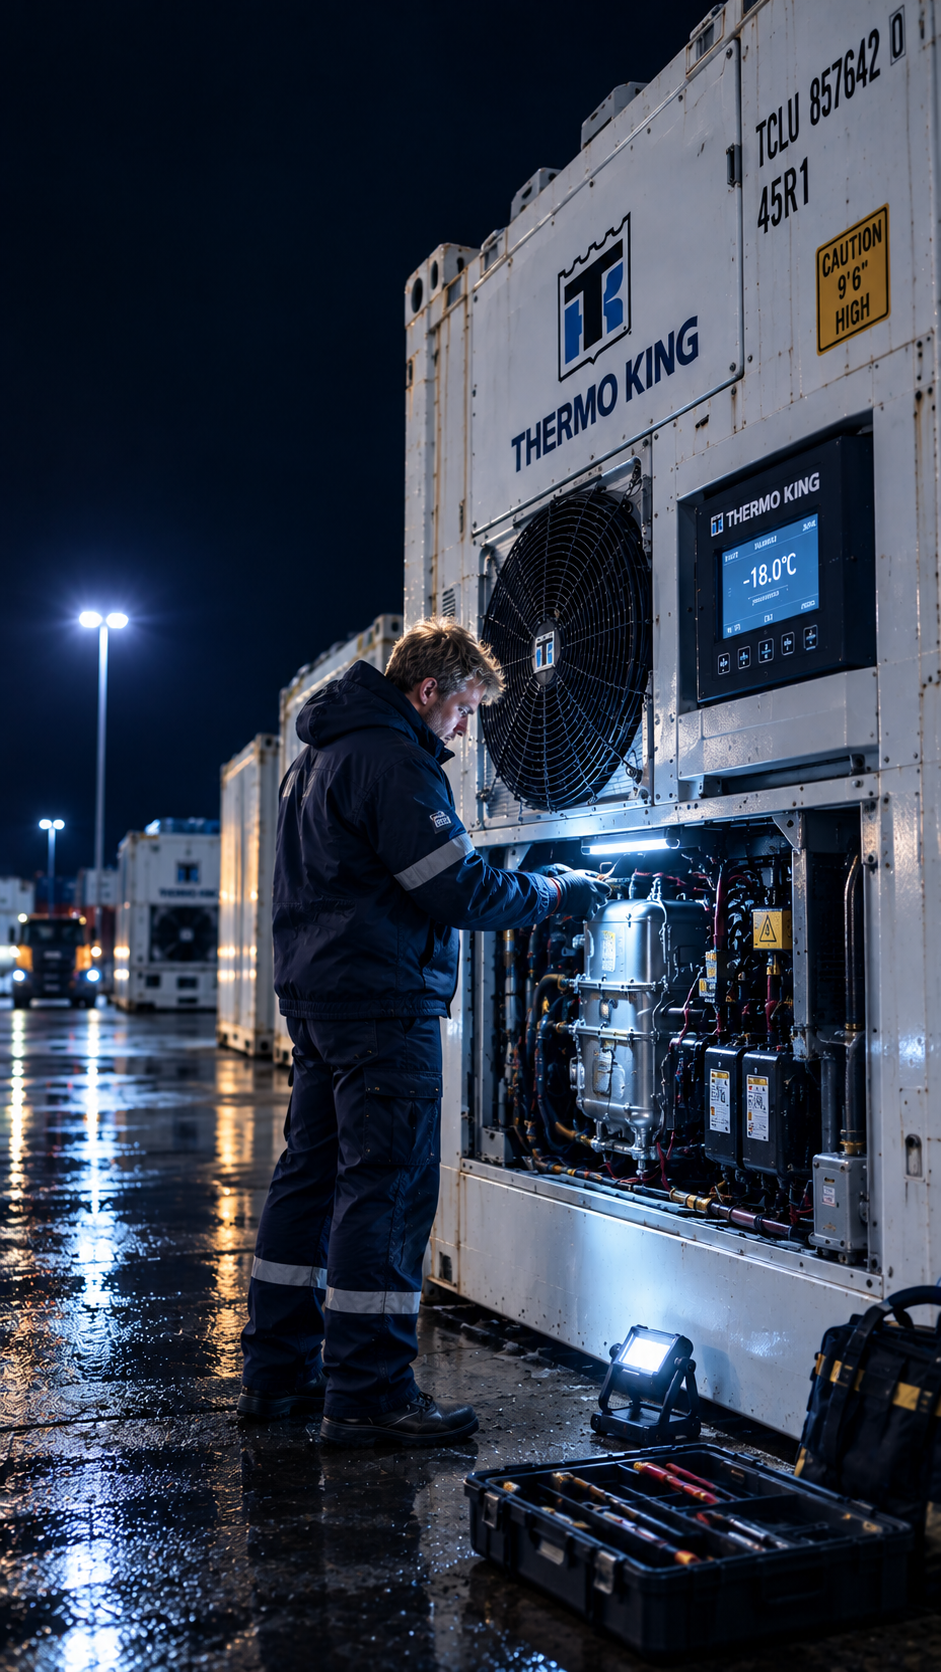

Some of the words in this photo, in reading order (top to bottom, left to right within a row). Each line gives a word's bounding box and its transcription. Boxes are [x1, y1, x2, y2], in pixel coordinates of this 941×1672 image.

[755, 92, 800, 168] TCLU
[809, 28, 881, 126] 857642
[757, 156, 809, 235] 45R1
[821, 219, 882, 278] CAUTION
[837, 259, 868, 300] 9'6"
[835, 292, 870, 335] HIGH
[511, 373, 618, 473] THERMO
[625, 315, 698, 403] KING
[726, 490, 781, 528] THERMO
[784, 472, 820, 504] KING
[743, 552, 797, 588] -18.0°C
